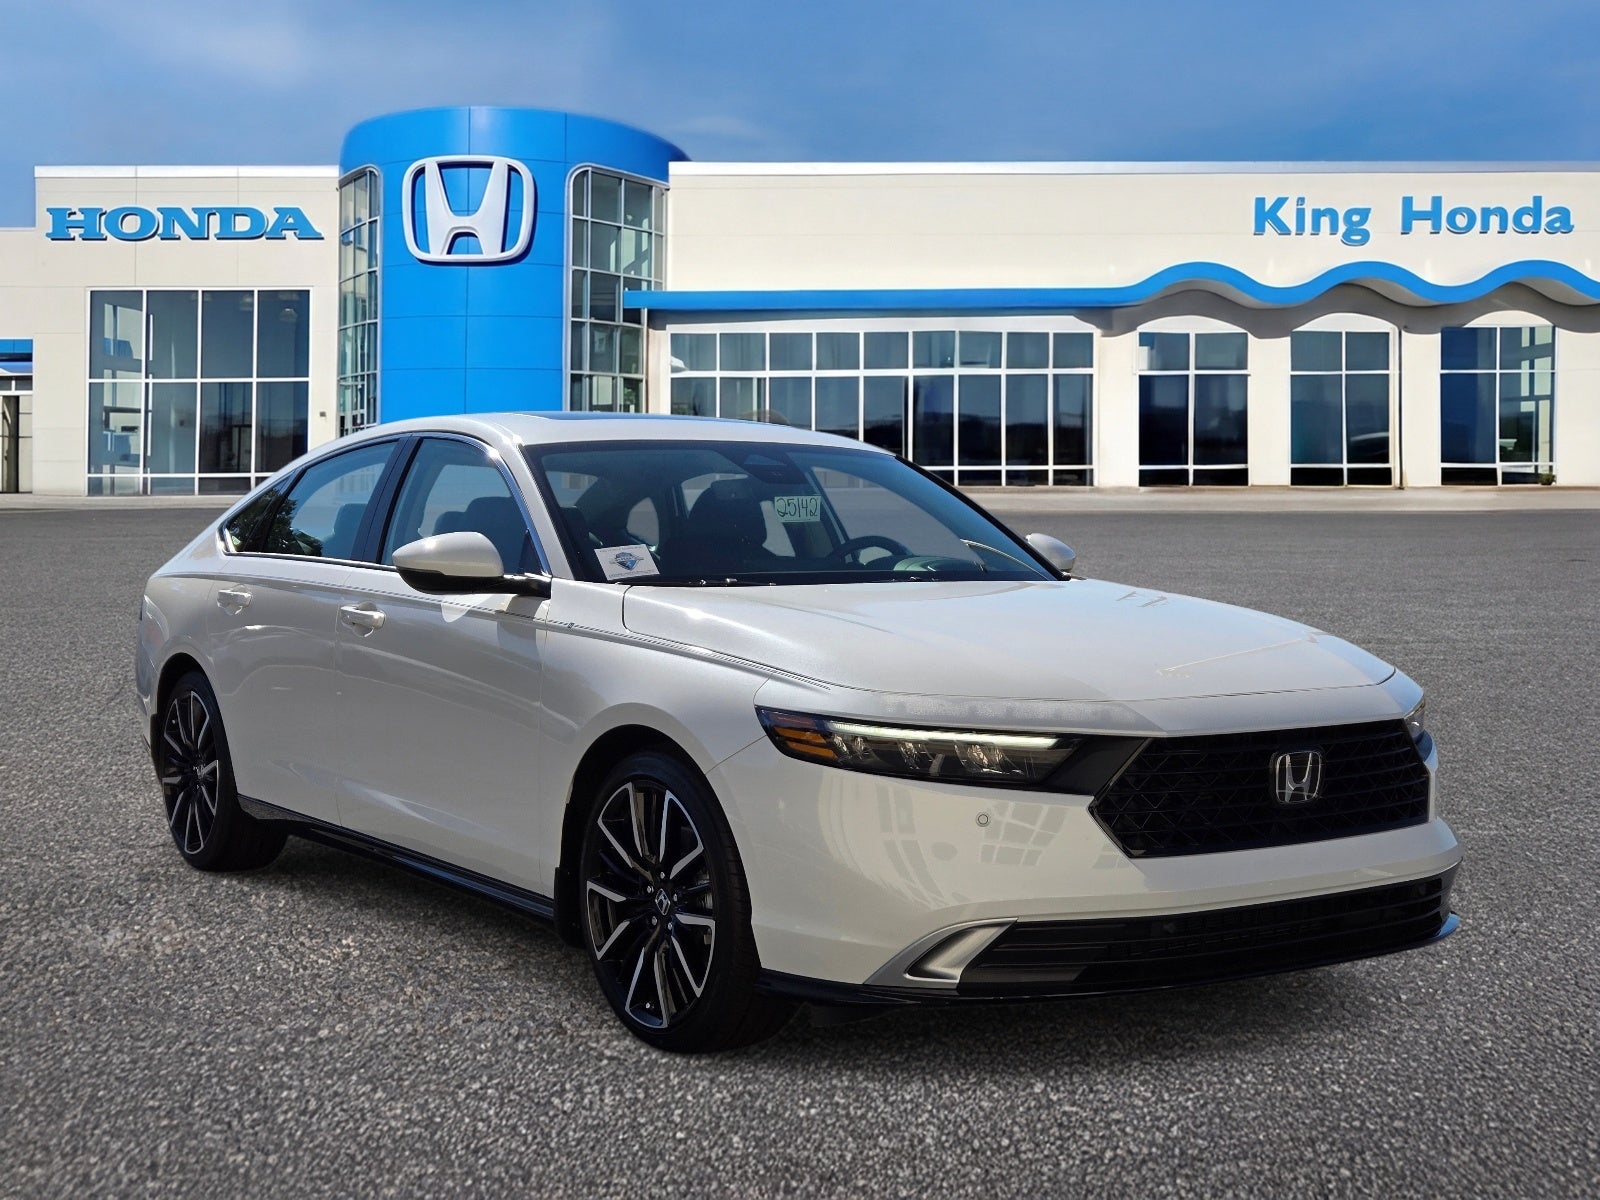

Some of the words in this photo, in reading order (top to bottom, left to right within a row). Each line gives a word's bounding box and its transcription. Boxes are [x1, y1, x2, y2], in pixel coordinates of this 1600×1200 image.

[46, 206, 324, 241] HONDA
[1254, 196, 1372, 247] King
[1400, 195, 1575, 235] Honda
[776, 497, 818, 518] 25142
